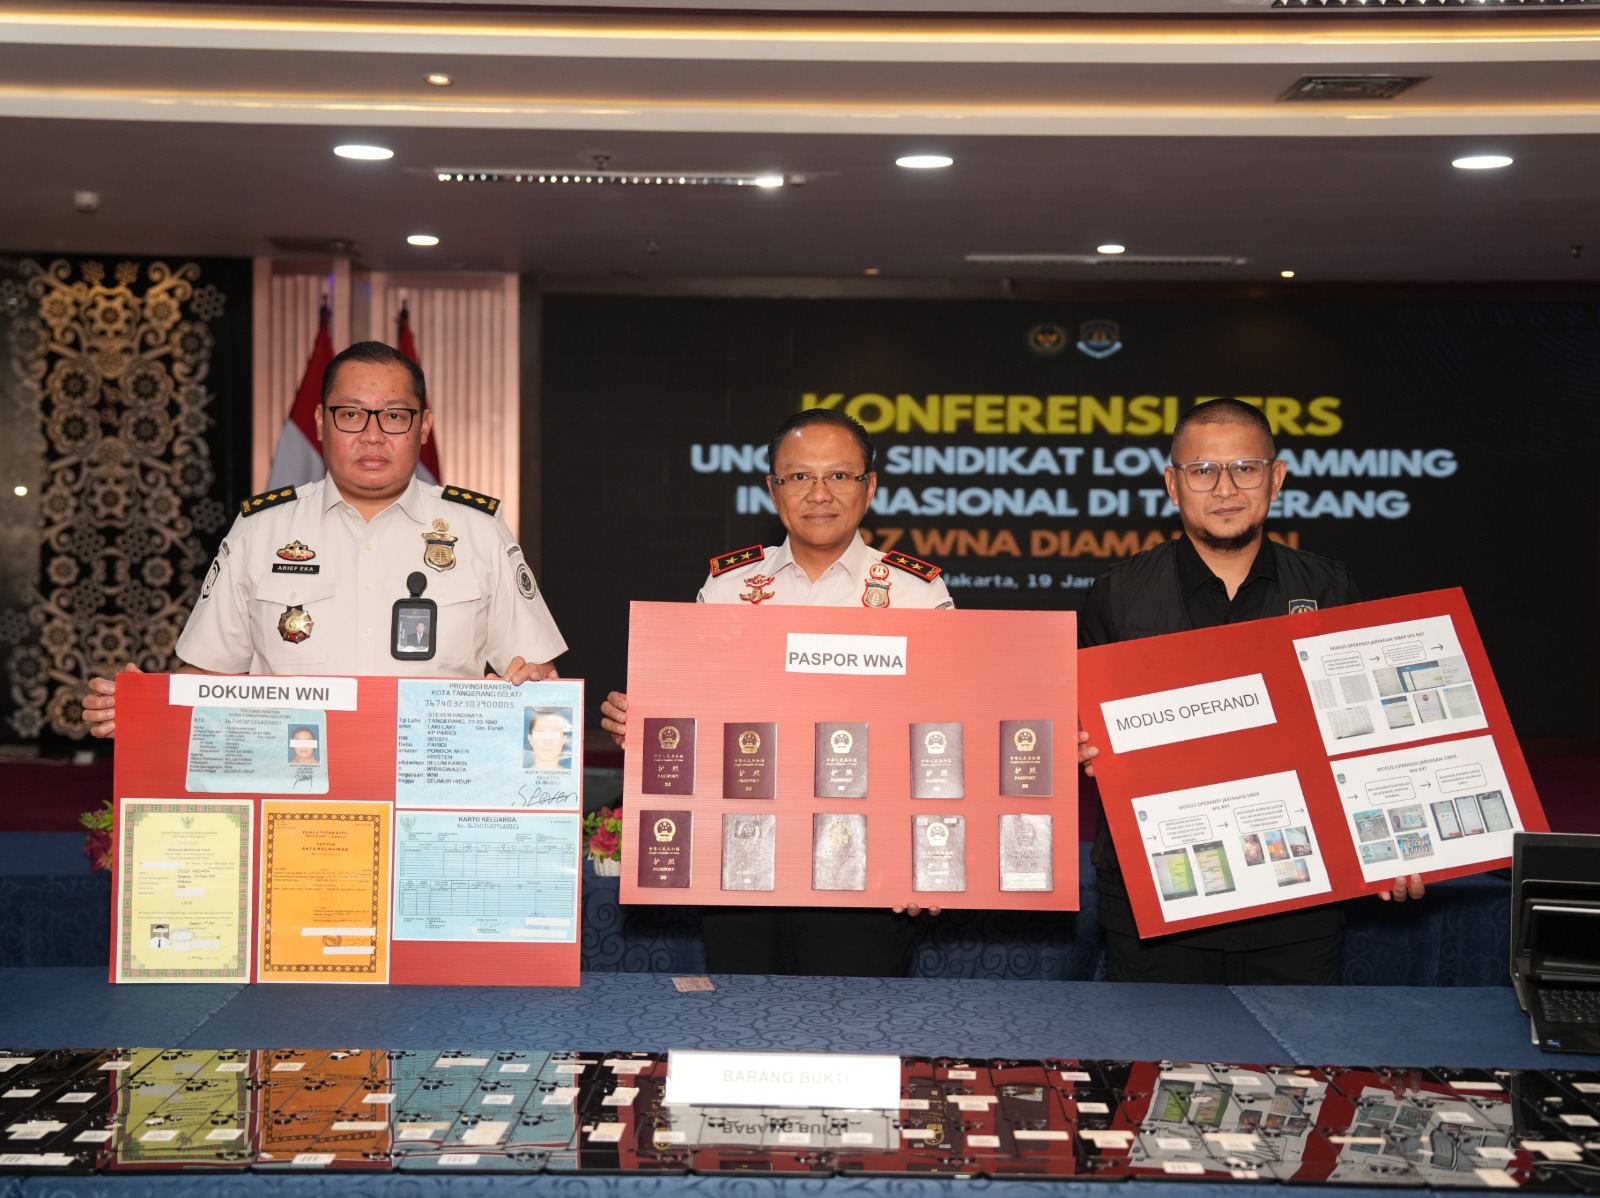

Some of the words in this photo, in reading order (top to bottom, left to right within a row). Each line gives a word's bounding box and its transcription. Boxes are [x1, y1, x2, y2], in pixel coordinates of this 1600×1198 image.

[800, 392, 1178, 435] KONFERENSI
[884, 445, 1084, 476] SINDIKAT
[1092, 448, 1174, 476] LOV
[1277, 448, 1458, 478] AMMING
[1088, 489, 1129, 518] DI
[1138, 489, 1410, 519] TAERANG
[911, 529, 1022, 557] WNA
[1027, 574, 1053, 588] 19
[789, 652, 858, 667] PASPOR
[863, 654, 904, 668] WNA
[198, 685, 290, 700] DOKUMEN
[296, 687, 329, 701] WNI
[1116, 709, 1175, 731] MODUS
[1179, 692, 1260, 719] OPERANDI
[1394, 760, 1418, 770] OPERANDI
[1178, 802, 1197, 810] MODUS
[1197, 798, 1222, 808] OPERANDI
[723, 1069, 794, 1084] BARANG
[800, 1071, 848, 1084] BUKTI
